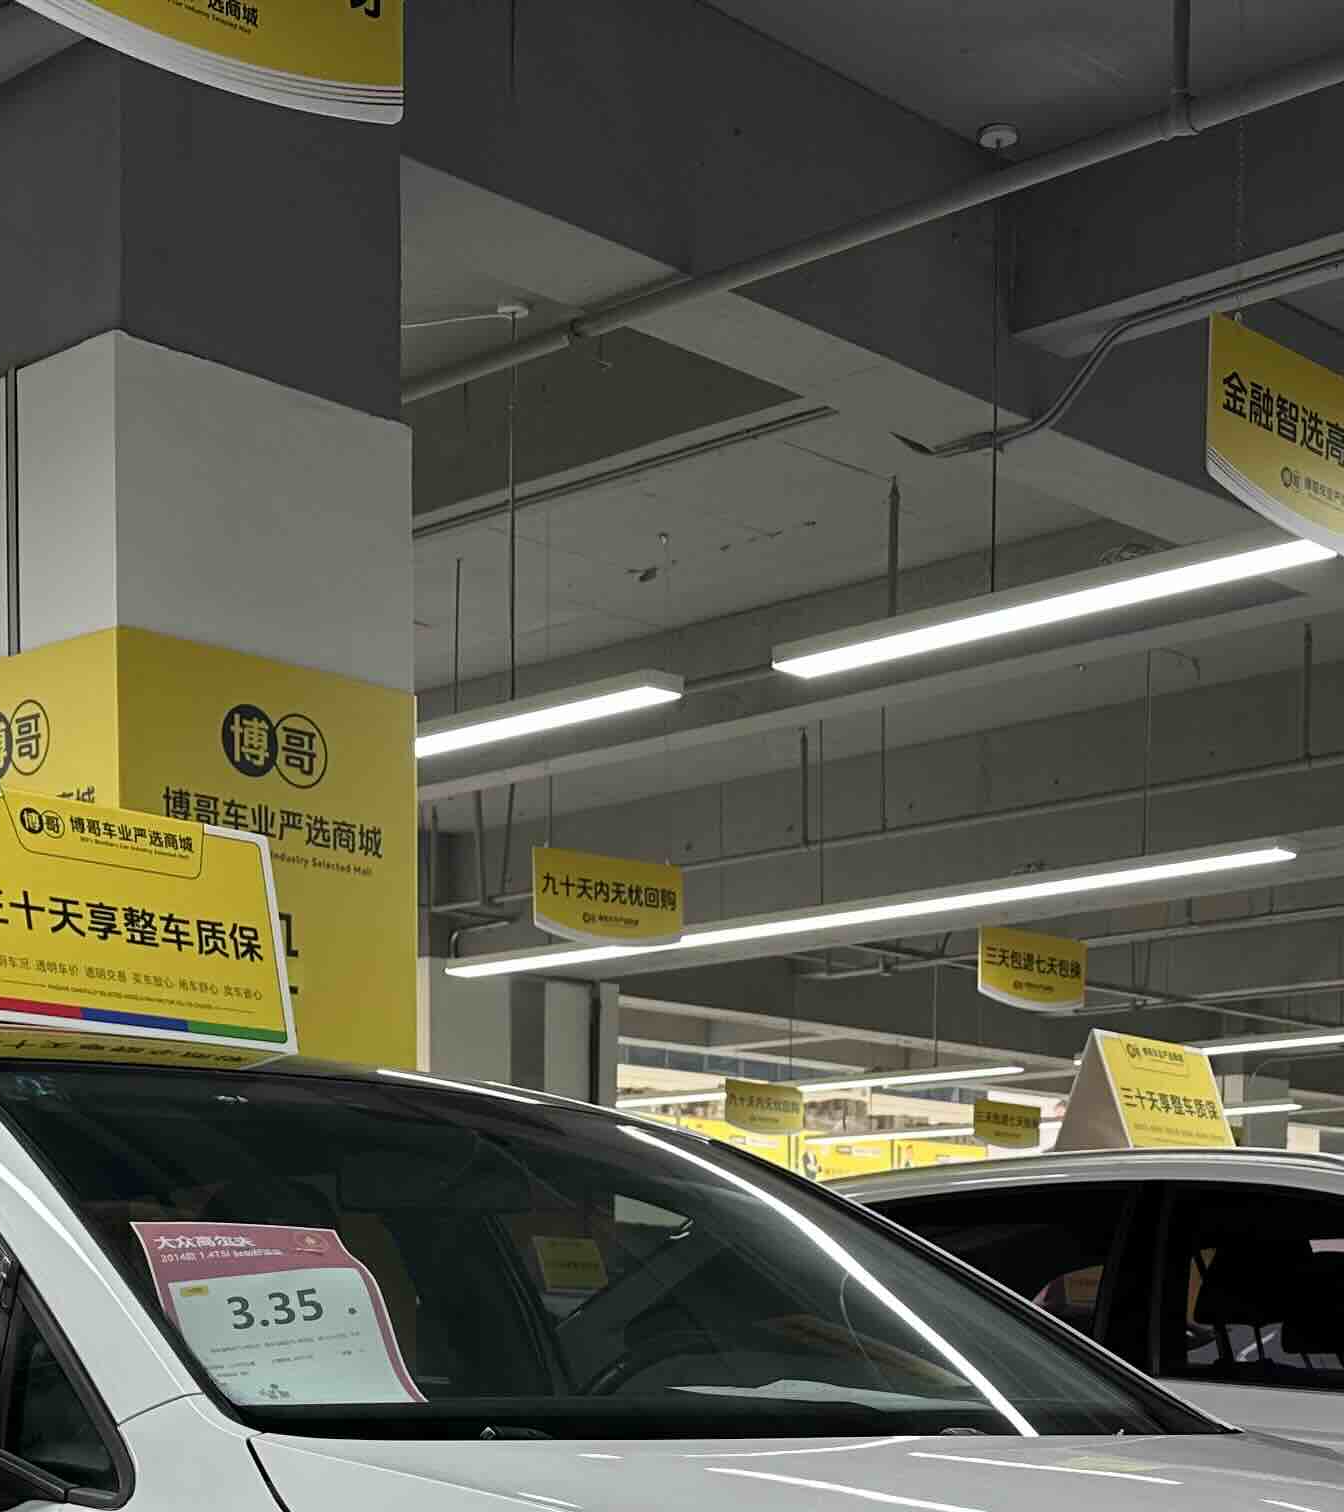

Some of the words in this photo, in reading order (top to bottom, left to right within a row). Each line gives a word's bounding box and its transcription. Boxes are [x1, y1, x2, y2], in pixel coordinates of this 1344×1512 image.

[226, 709, 322, 781] 博哥
[69, 815, 194, 853] 博哥车业严选商城
[163, 786, 384, 859] 博哥车业严选商城
[542, 872, 677, 911] 九十天内无忧回购
[1120, 1087, 1219, 1120] 三十天享整车质保
[226, 1287, 323, 1330] 3.35
